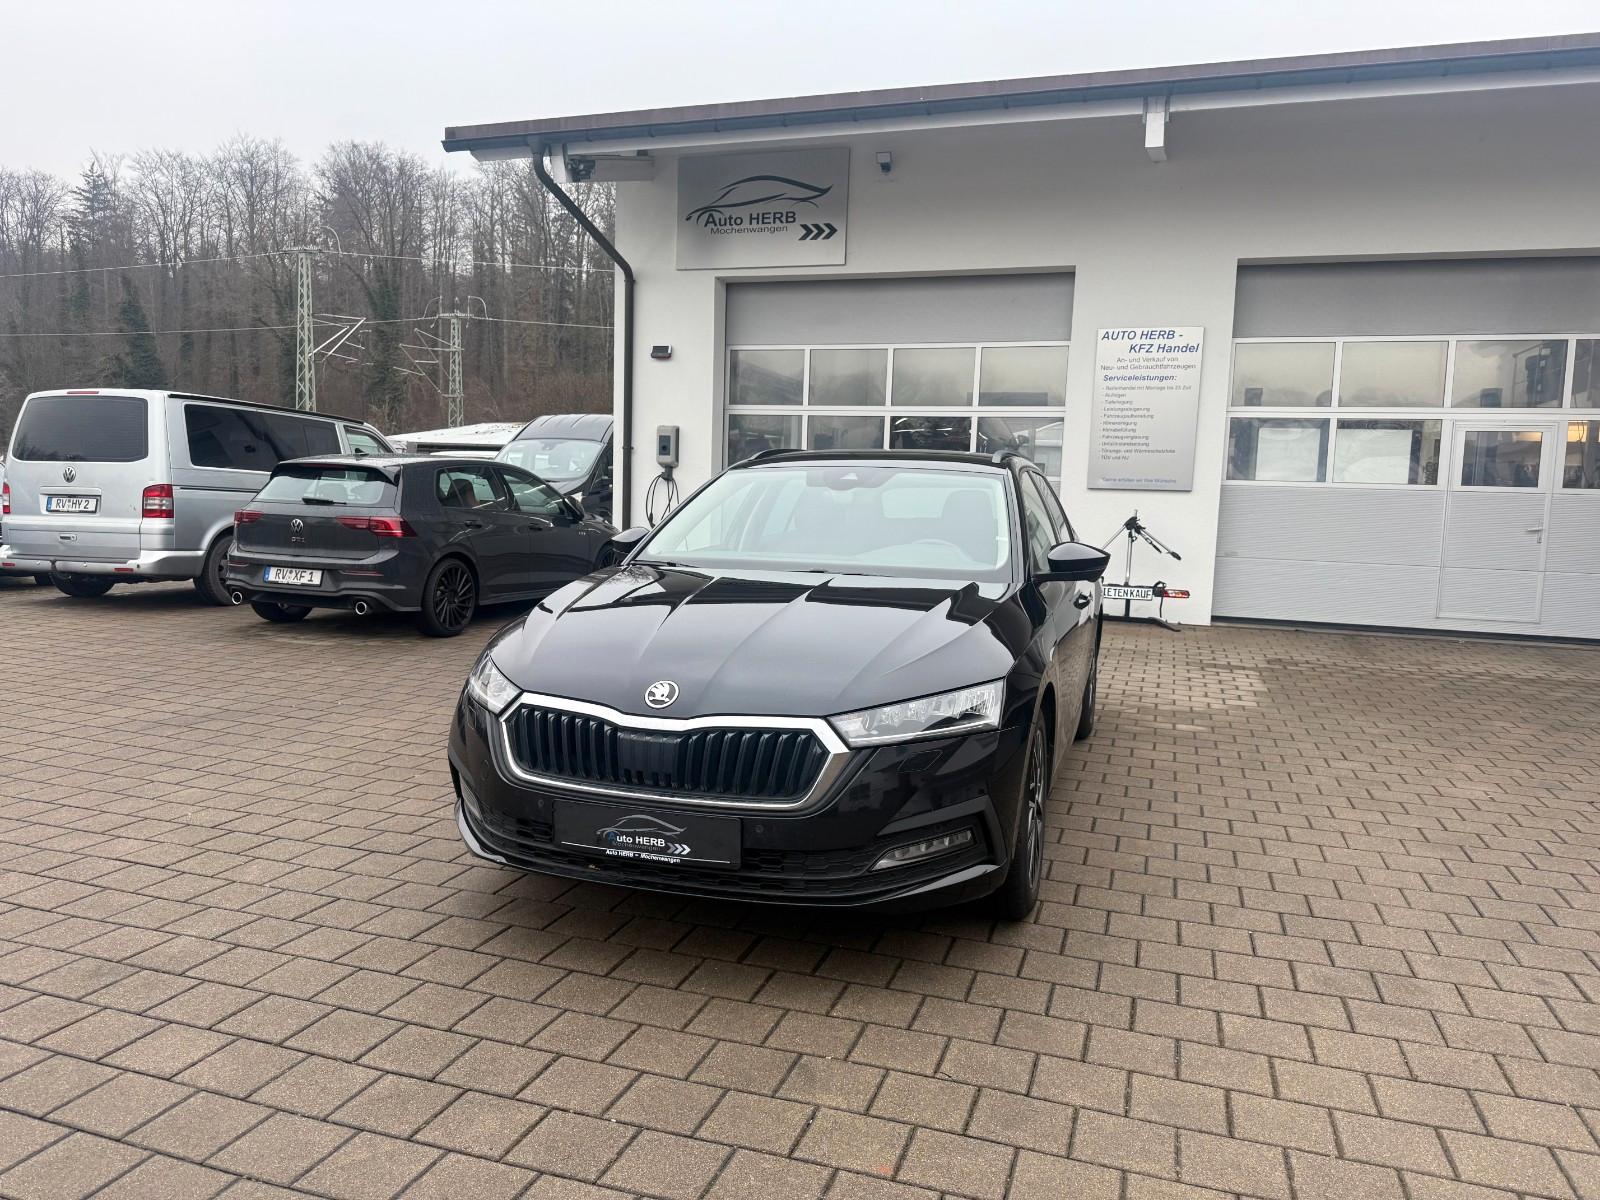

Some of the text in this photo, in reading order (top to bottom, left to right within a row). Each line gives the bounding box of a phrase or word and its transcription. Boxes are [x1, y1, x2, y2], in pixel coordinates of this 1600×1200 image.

[704, 211, 796, 228] Auto HERB
[710, 225, 788, 235] Mochenwangen
[1101, 330, 1137, 341] AUTO
[1140, 330, 1176, 340] HERB
[1128, 343, 1200, 354] KFZ Handel
[1103, 374, 1178, 382] Serviceleistungen:
[56, 498, 90, 509] RV HY 2
[275, 568, 314, 582] RV XF 1
[1104, 588, 1152, 599] IETENKAUF
[635, 835, 665, 847] HERB
